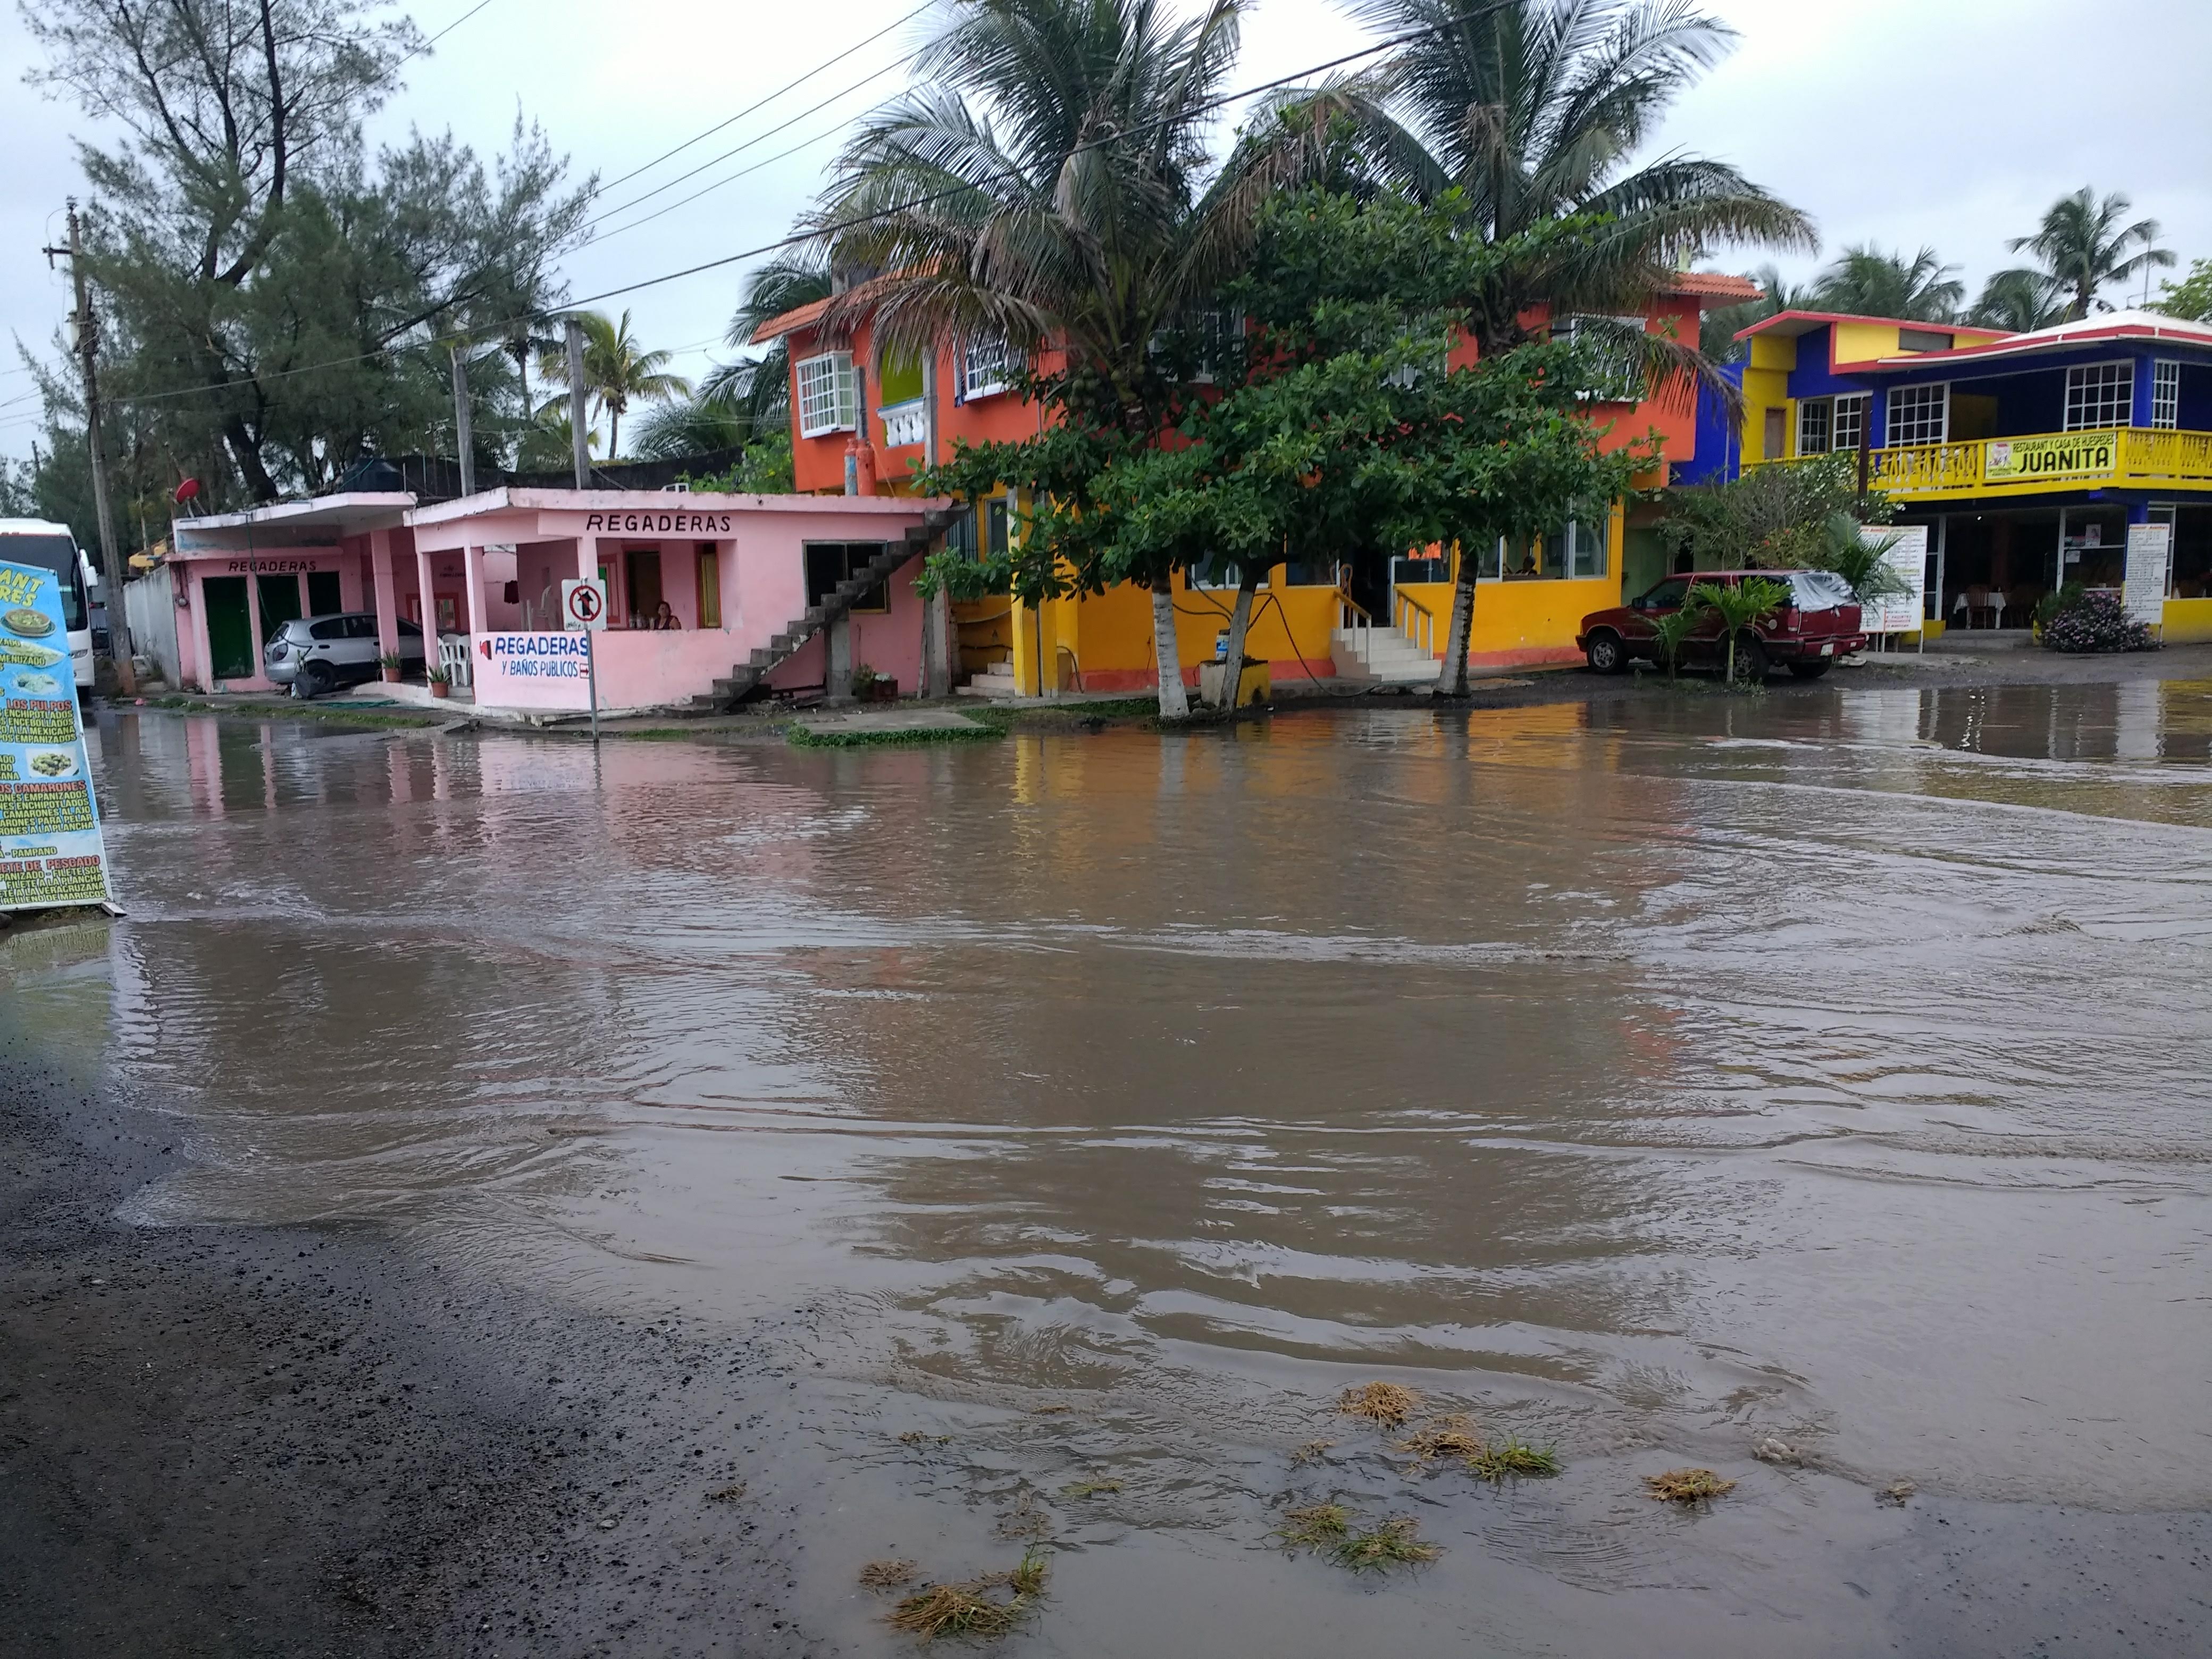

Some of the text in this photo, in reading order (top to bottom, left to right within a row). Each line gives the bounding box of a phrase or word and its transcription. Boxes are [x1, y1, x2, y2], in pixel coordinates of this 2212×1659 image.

[2013, 434, 2114, 452] RESTAURANT Y CASA DE HUESPEDES
[2019, 447, 2109, 473] JUANITA
[586, 514, 731, 532] REGADERAS
[228, 560, 316, 572] REGADERAS
[495, 636, 588, 656] REGADERAS
[502, 658, 578, 678] Y BAÑOS PUBLICOS
[7, 698, 72, 711] LOS PULPOS
[4, 709, 73, 719] ENCHIPOTLADOS
[8, 717, 74, 727] ENCEBOLLADOS
[9, 726, 15, 734] A
[29, 725, 76, 735] MEXICANA
[15, 734, 77, 743] EMPANIZADOS
[14, 780, 86, 793] CAMARONES
[24, 790, 88, 801] EMPANIZADOS
[16, 798, 89, 810] ENCHIPOTLADOS
[3, 805, 91, 819] CAMARONES AL AJO
[38, 816, 62, 825] PARA
[64, 814, 93, 824] PELAR
[30, 826, 37, 834] A
[38, 825, 52, 834] LA
[52, 821, 95, 833] PLANCHA
[11, 847, 57, 858] PAMPANO
[0, 855, 100, 873] ETE DE PESCADO
[52, 867, 83, 877] FILETE
[85, 866, 102, 875] SOL
[6, 874, 104, 889] FILETE A LA PLANCHA
[16, 888, 24, 897] A
[24, 887, 38, 896] LA
[38, 882, 106, 894] VERACRUZANA
[3, 895, 45, 904] RELLENO
[60, 890, 106, 901] MARISCOS
